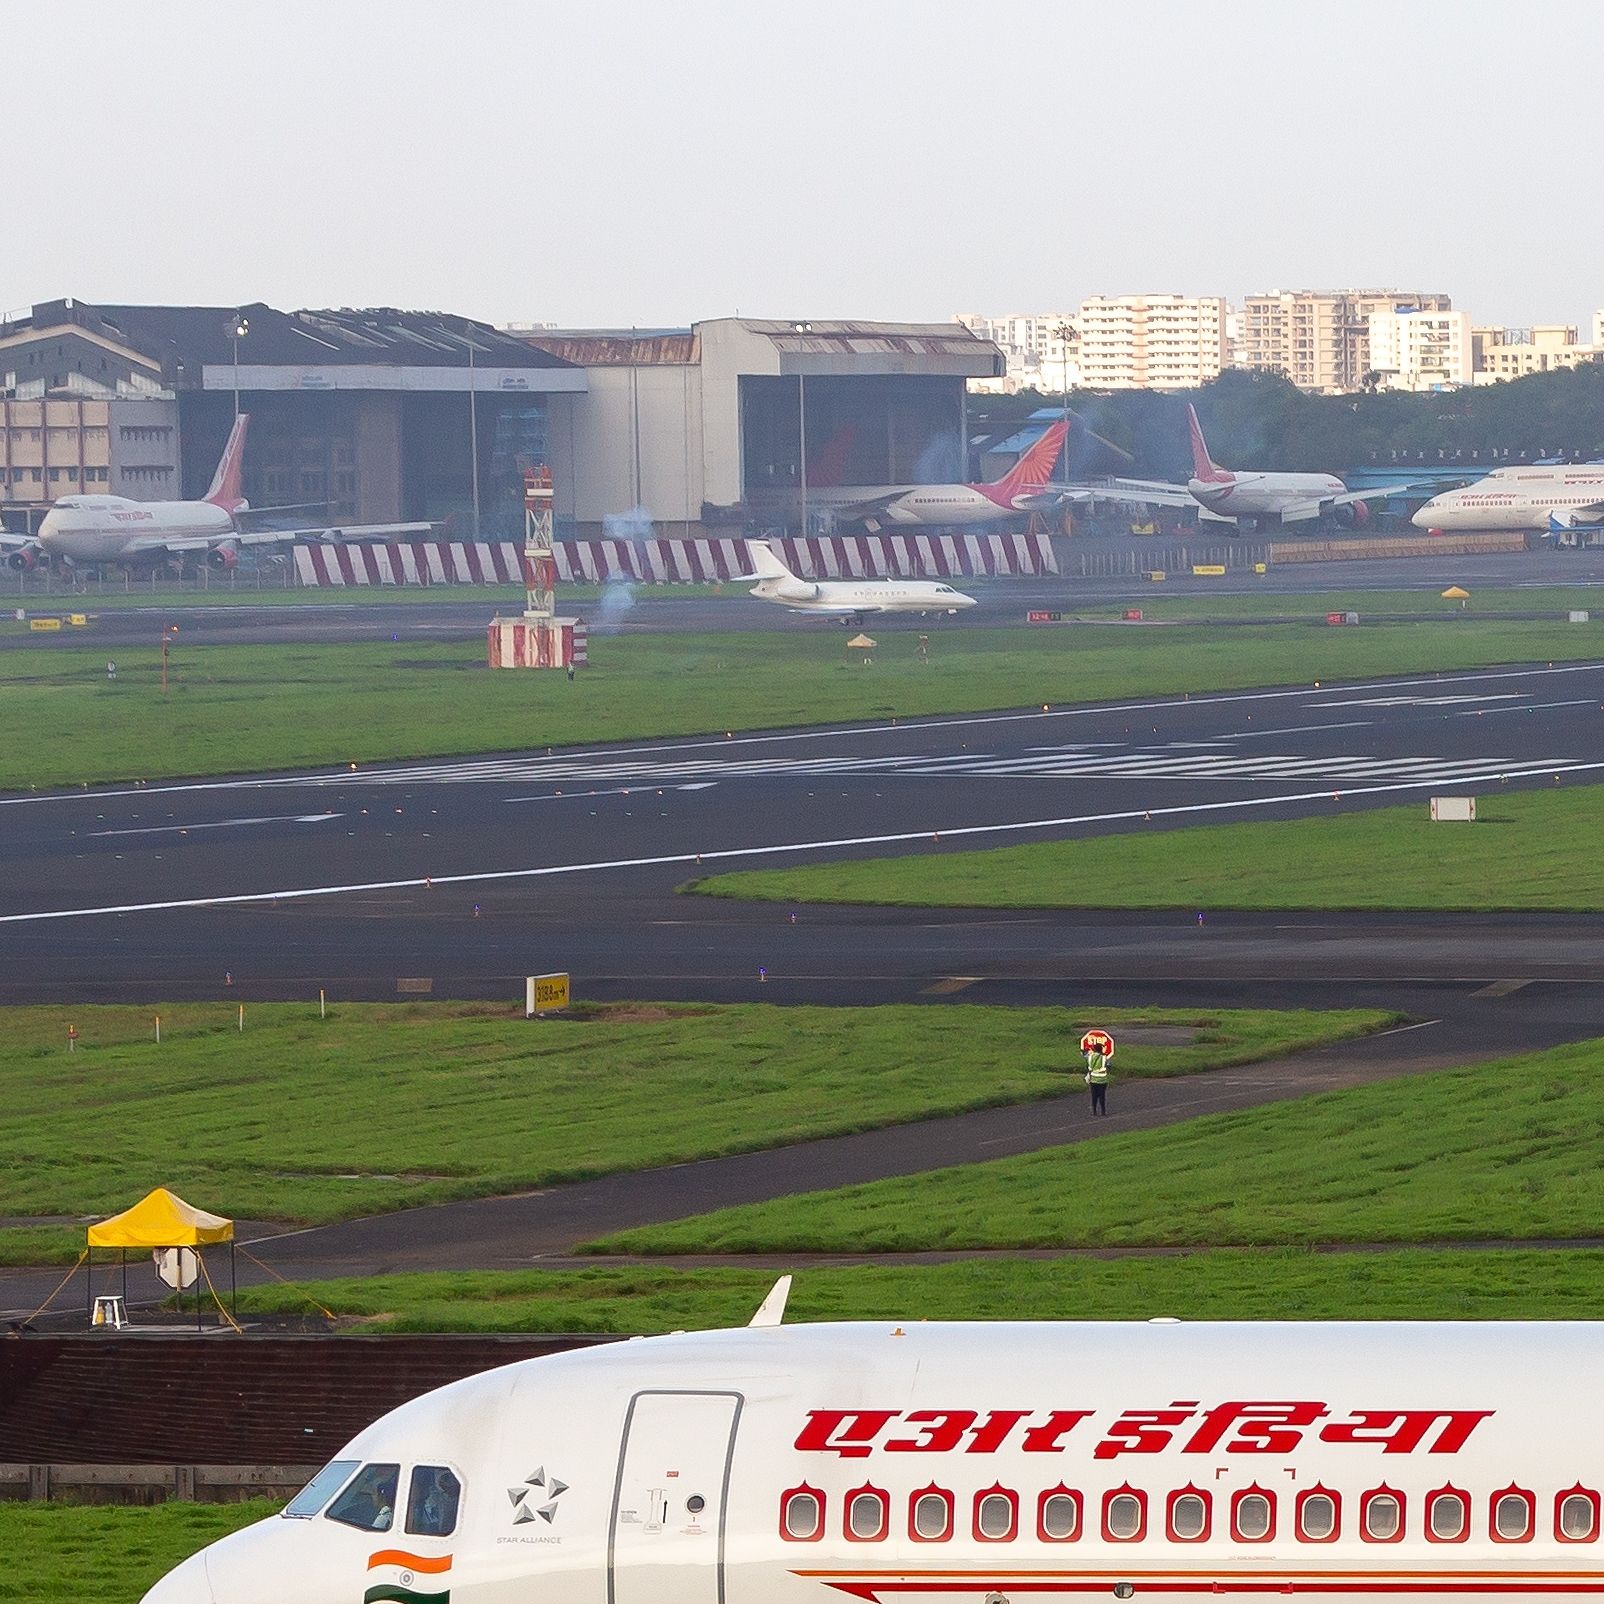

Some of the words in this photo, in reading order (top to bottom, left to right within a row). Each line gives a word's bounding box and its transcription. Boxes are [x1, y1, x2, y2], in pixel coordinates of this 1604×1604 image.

[1094, 1400, 1497, 1460] इंडिया
[496, 1536, 518, 1544] STAR
[520, 1536, 562, 1544] ALLIANCE
